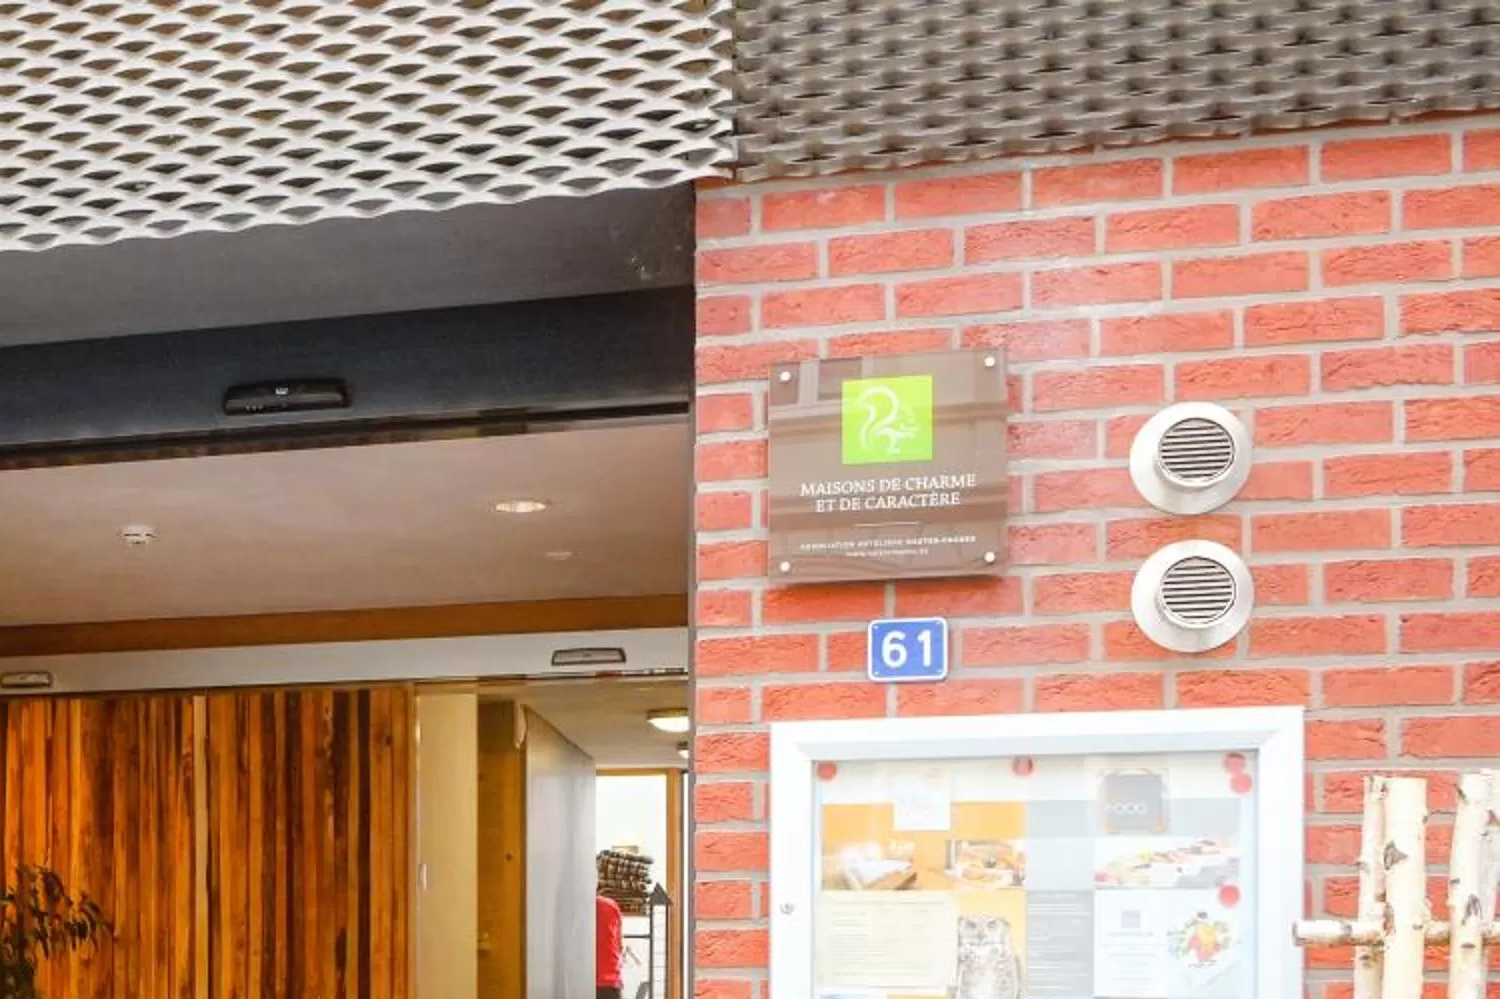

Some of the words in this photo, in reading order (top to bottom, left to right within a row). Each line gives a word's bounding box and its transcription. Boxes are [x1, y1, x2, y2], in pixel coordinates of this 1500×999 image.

[800, 478, 875, 497] MAISONS
[879, 477, 901, 493] DE
[905, 473, 977, 492] CHARME
[815, 498, 837, 513] ET
[839, 497, 861, 511] DE
[865, 490, 961, 510] CARACTÈRE
[882, 629, 932, 668] 61
